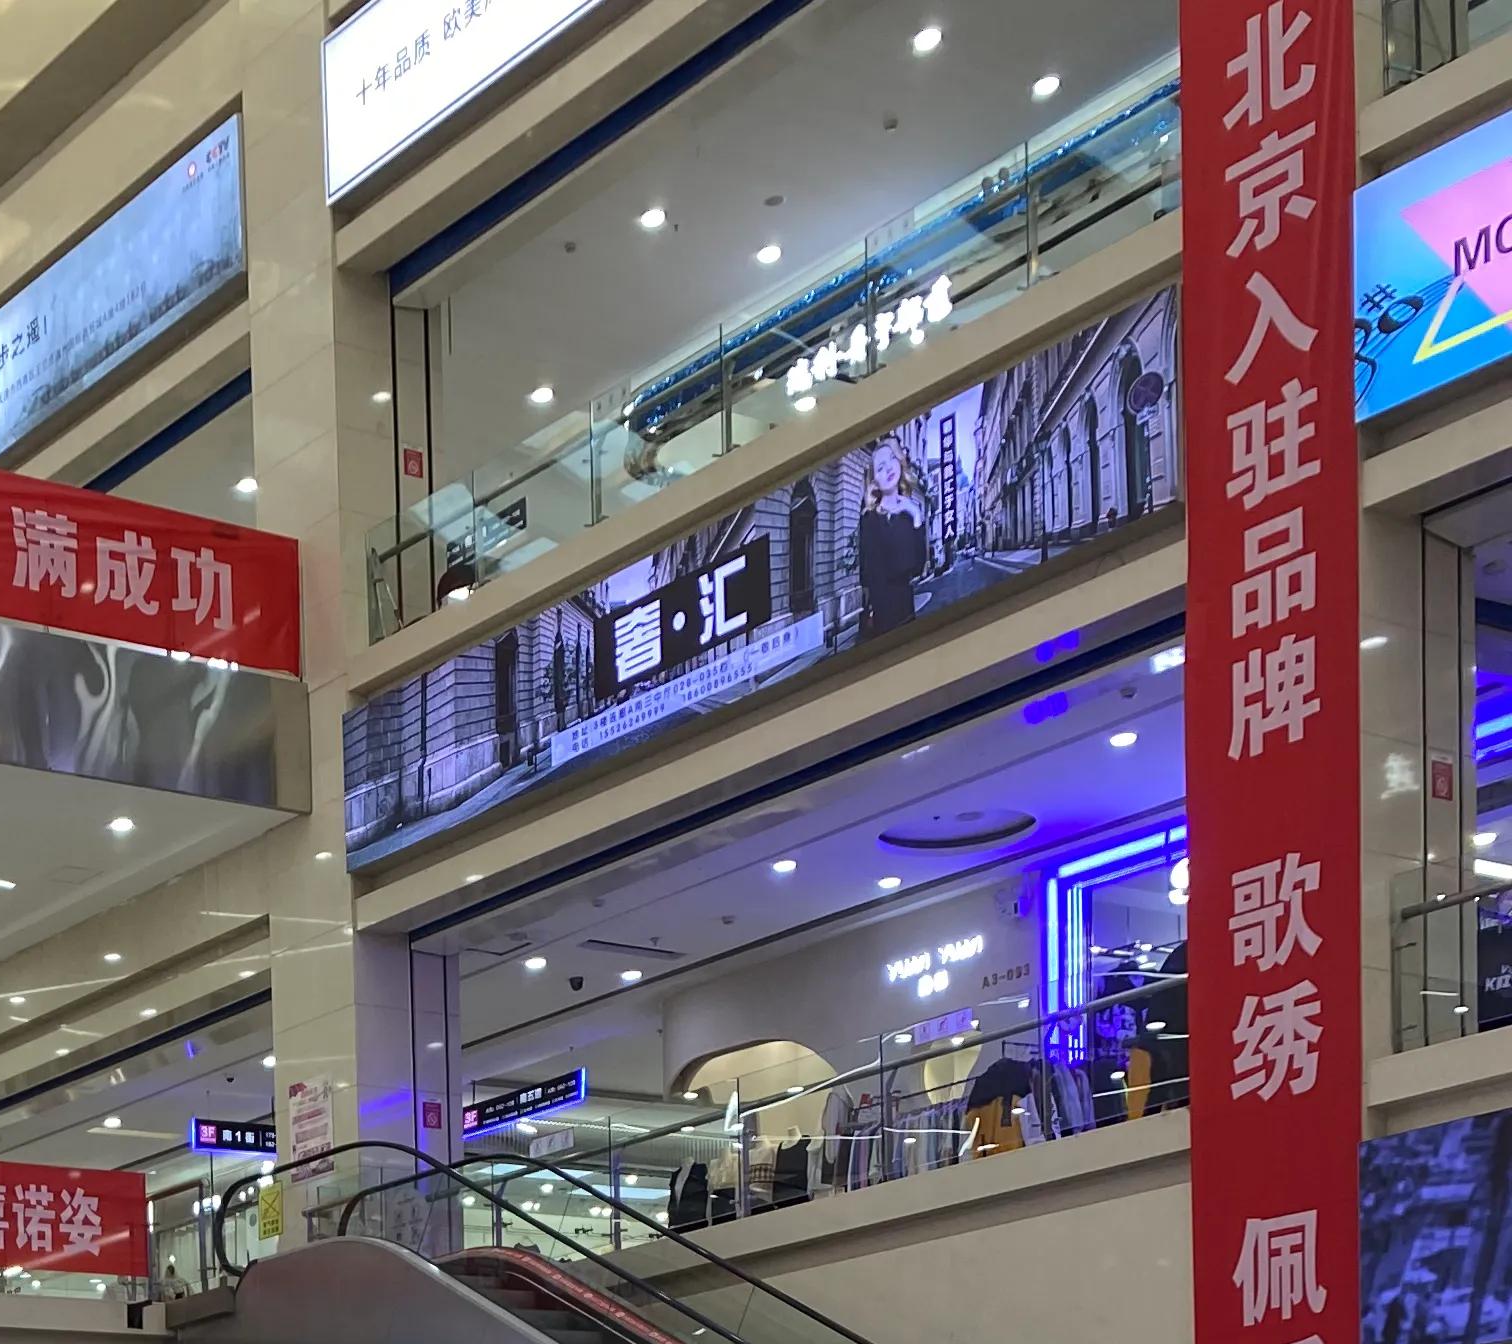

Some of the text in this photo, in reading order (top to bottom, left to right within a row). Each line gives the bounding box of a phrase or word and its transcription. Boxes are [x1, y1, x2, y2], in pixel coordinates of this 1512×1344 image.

[356, 0, 491, 105] 十年品质 欧美
[1223, 0, 1321, 762] 北京入驻品牌
[1228, 852, 1323, 1102] 歌绣
